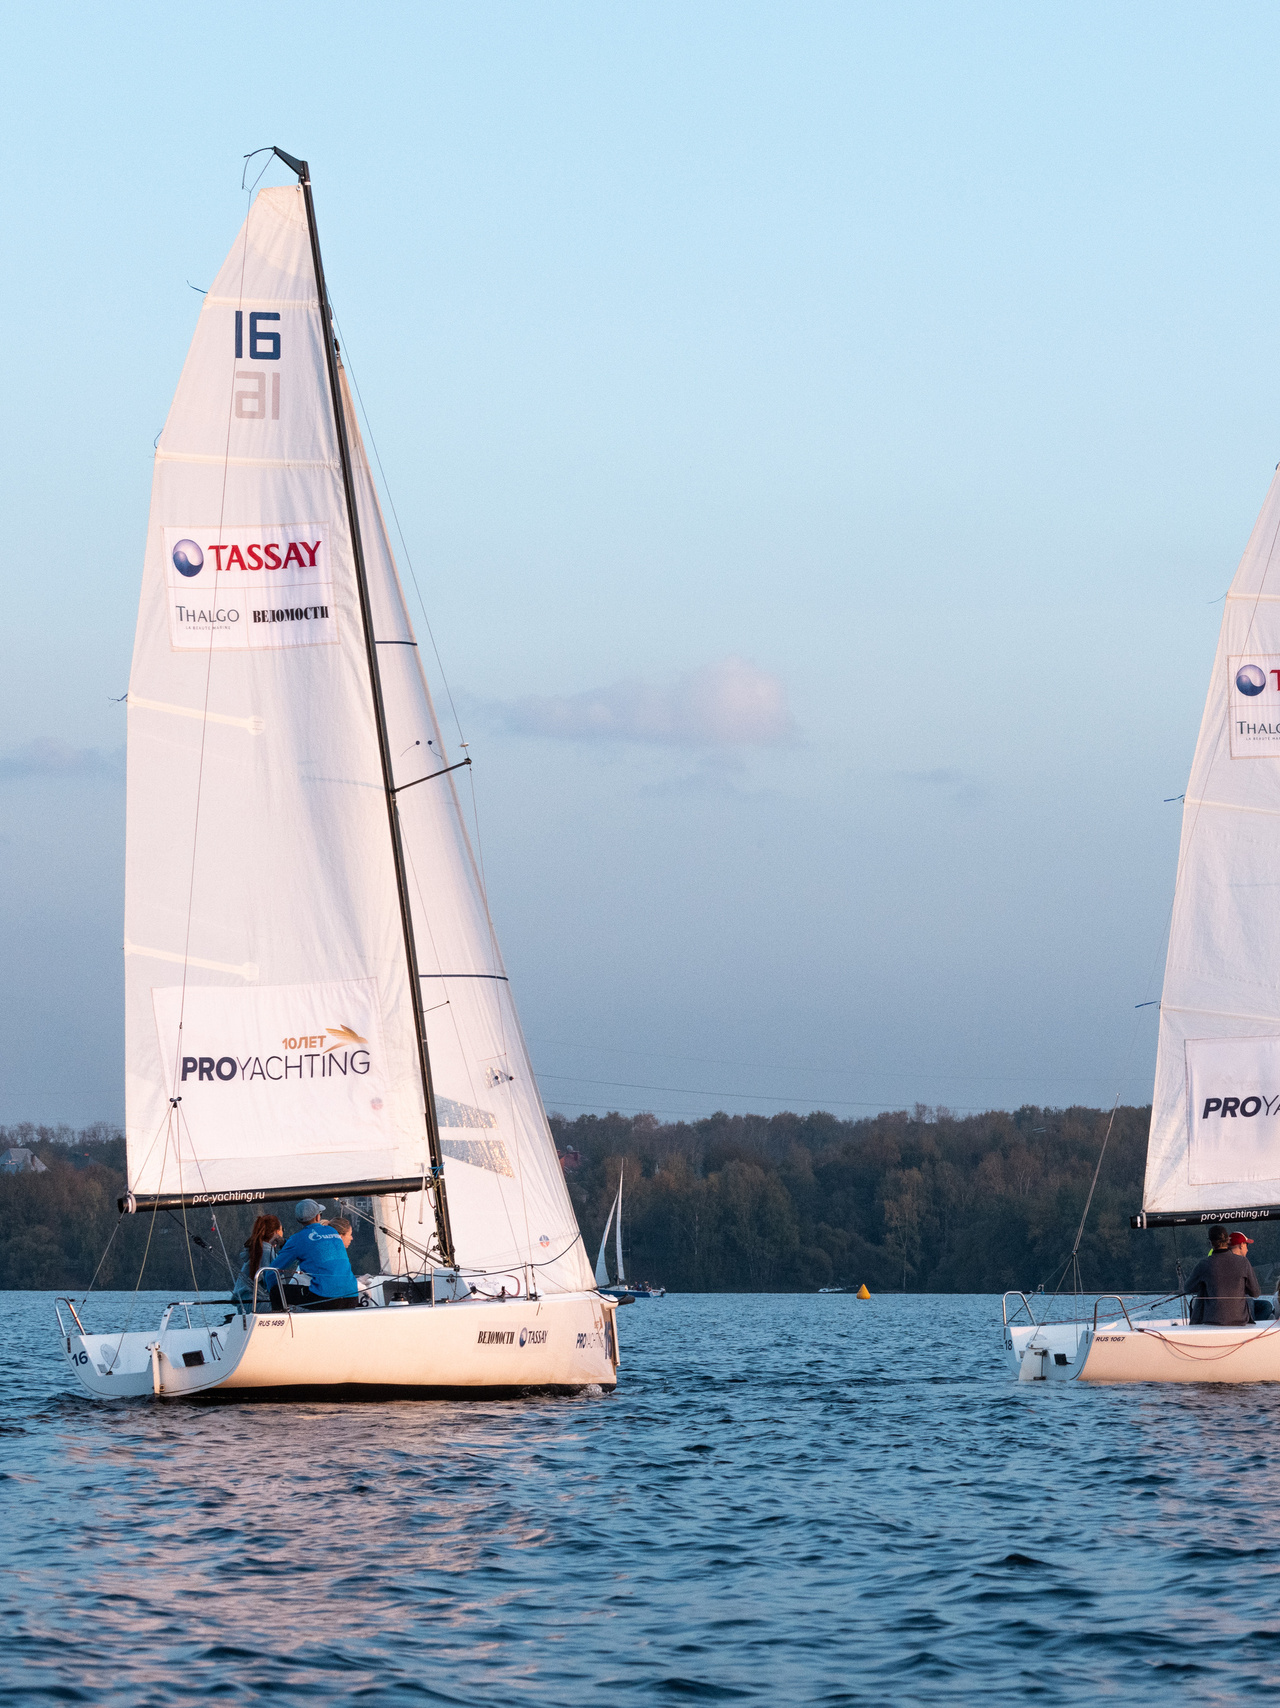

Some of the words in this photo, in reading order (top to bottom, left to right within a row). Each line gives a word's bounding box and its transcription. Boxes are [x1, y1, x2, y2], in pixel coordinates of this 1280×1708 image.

[235, 311, 281, 360] 16
[208, 541, 321, 570] TASSAY
[253, 606, 328, 622] ВЕДОМОСТИ
[193, 1191, 265, 1205] pro-yachting.ru
[1201, 1210, 1270, 1222] pro-yachting.ru
[528, 1331, 548, 1344] TASSAY
[1004, 1340, 1012, 1350] 18
[72, 1351, 88, 1366] 16
